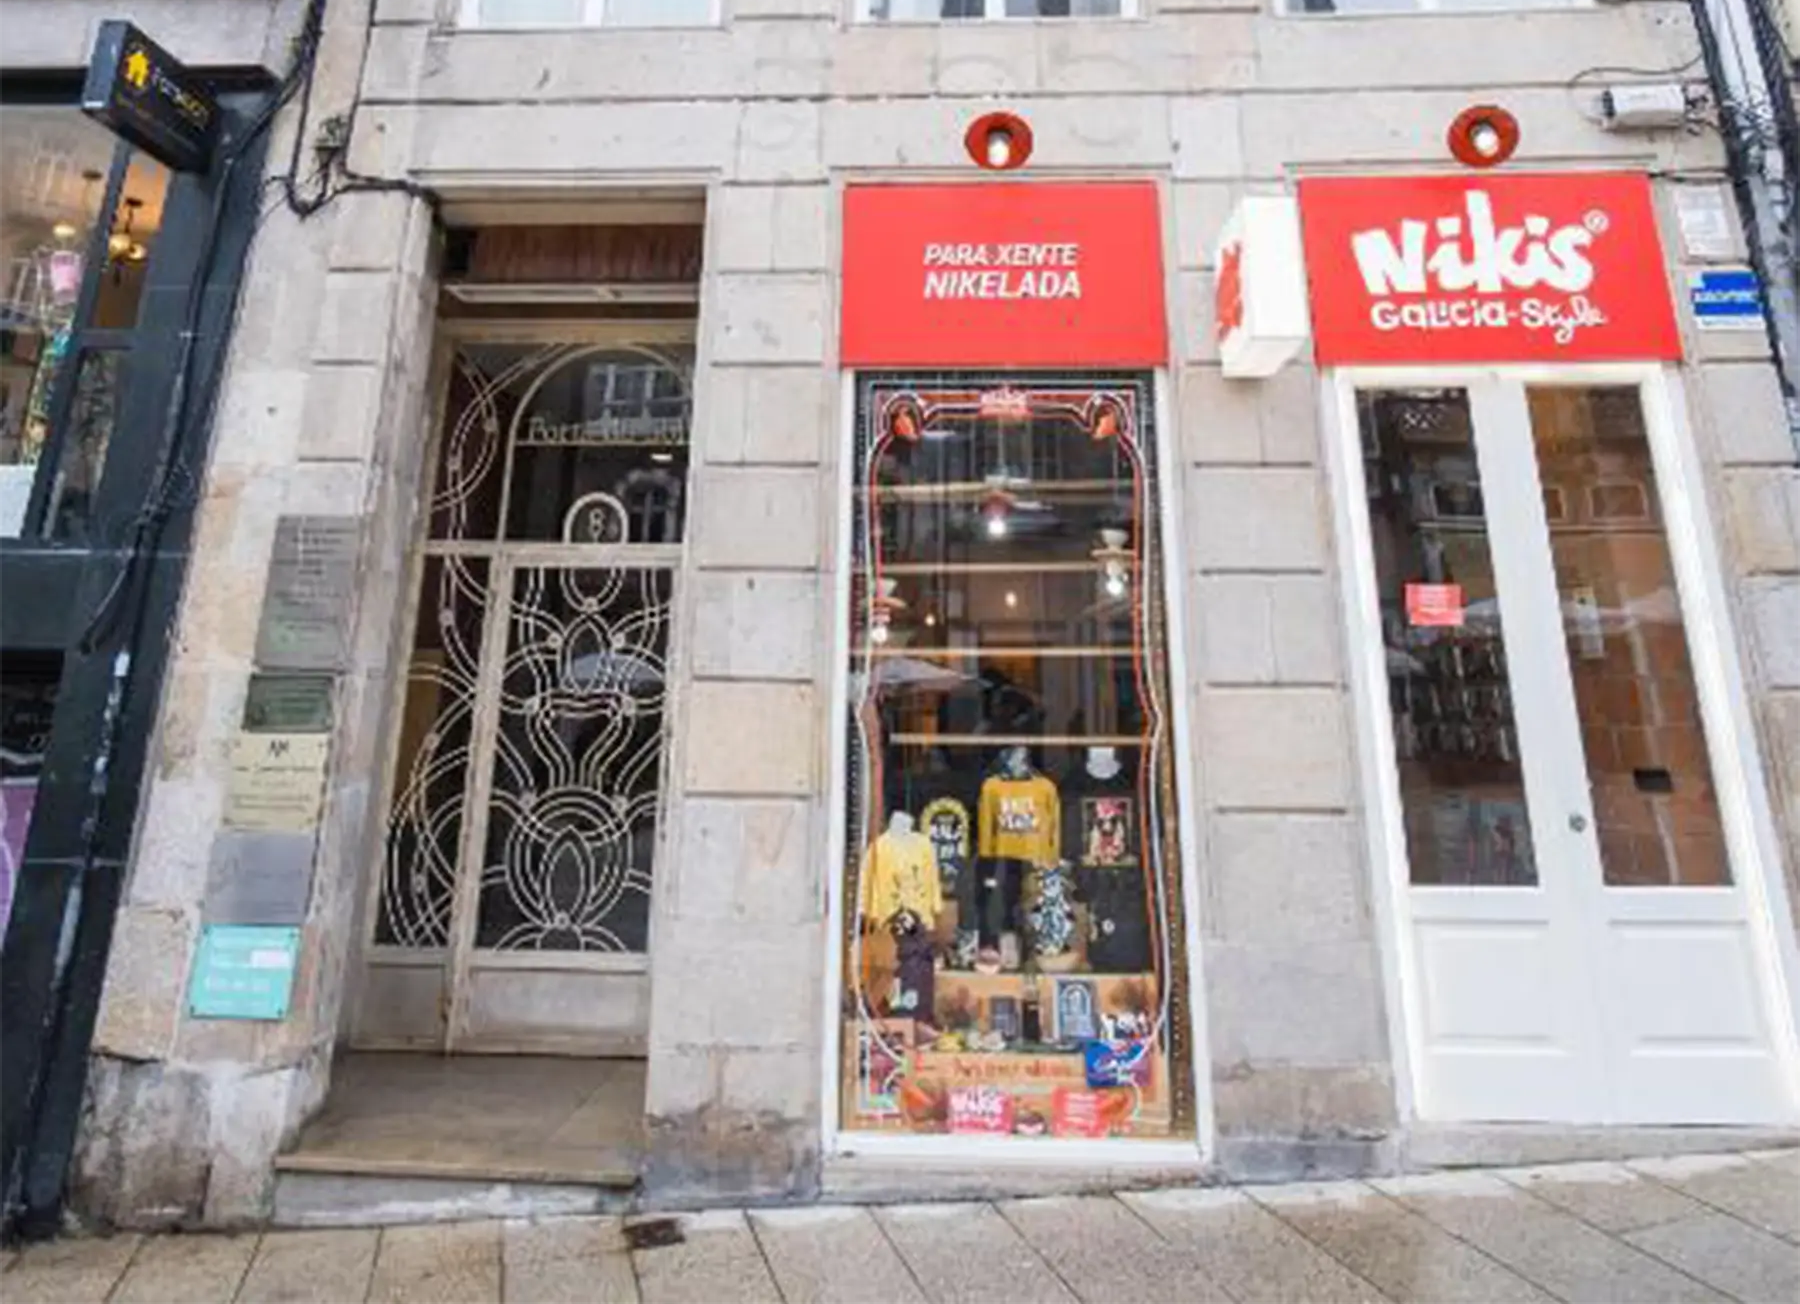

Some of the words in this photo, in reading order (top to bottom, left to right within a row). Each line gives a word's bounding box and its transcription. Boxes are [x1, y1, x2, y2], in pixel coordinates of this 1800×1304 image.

[923, 243, 989, 267] PARA
[994, 243, 1080, 267] XENTE
[923, 270, 1082, 300] NIKELADA
